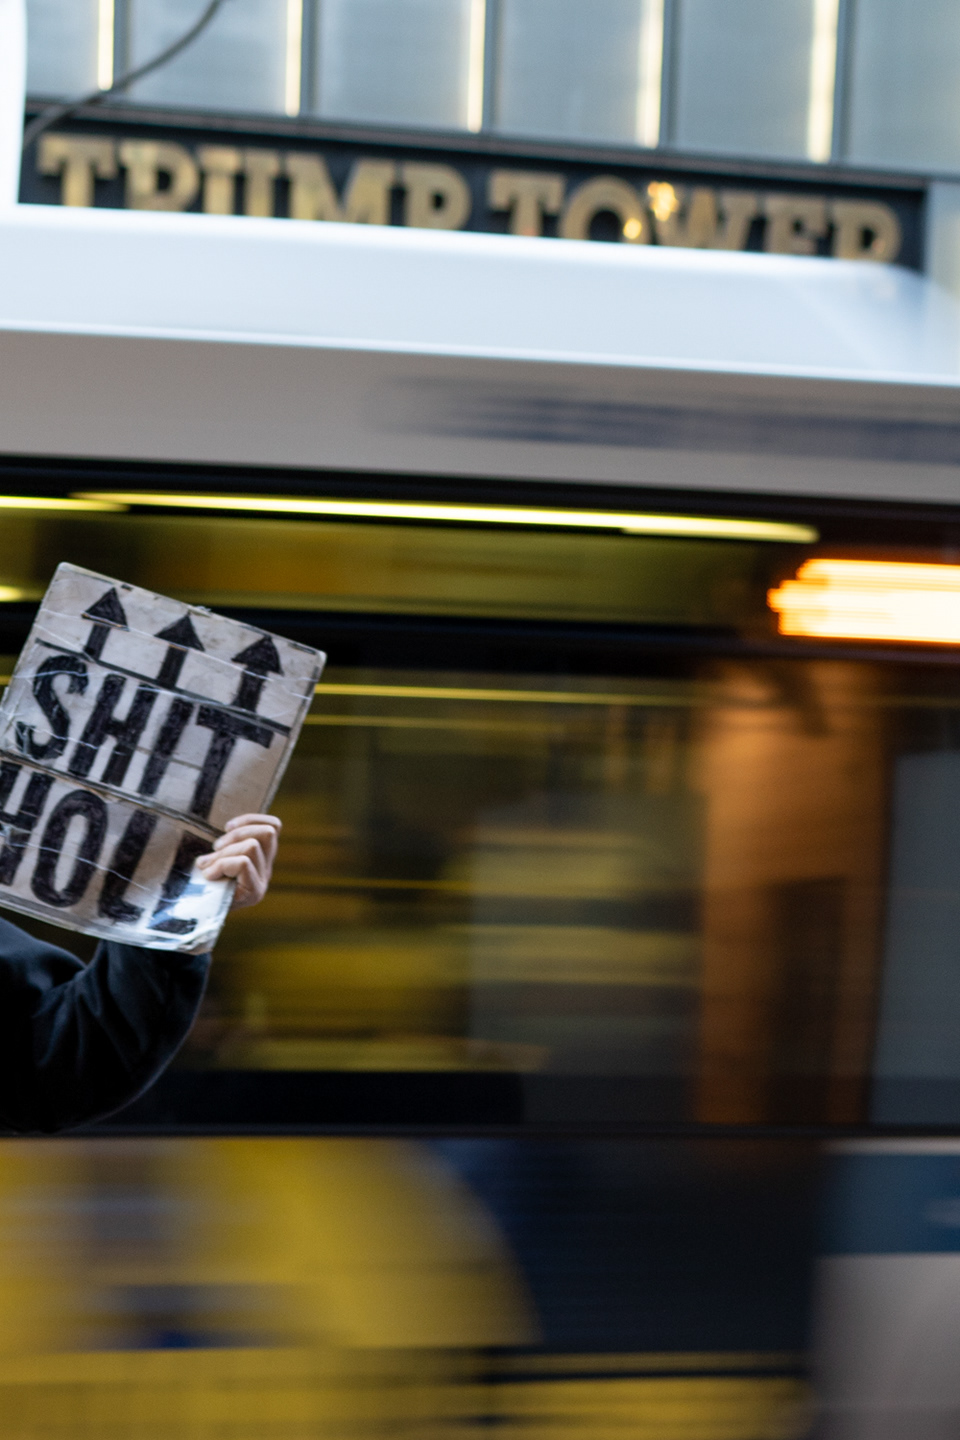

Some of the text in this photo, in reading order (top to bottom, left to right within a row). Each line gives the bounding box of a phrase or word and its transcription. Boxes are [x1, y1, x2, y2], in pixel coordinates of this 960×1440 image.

[43, 134, 899, 262] TRUMP TOWER
[14, 654, 274, 820] SHIT
